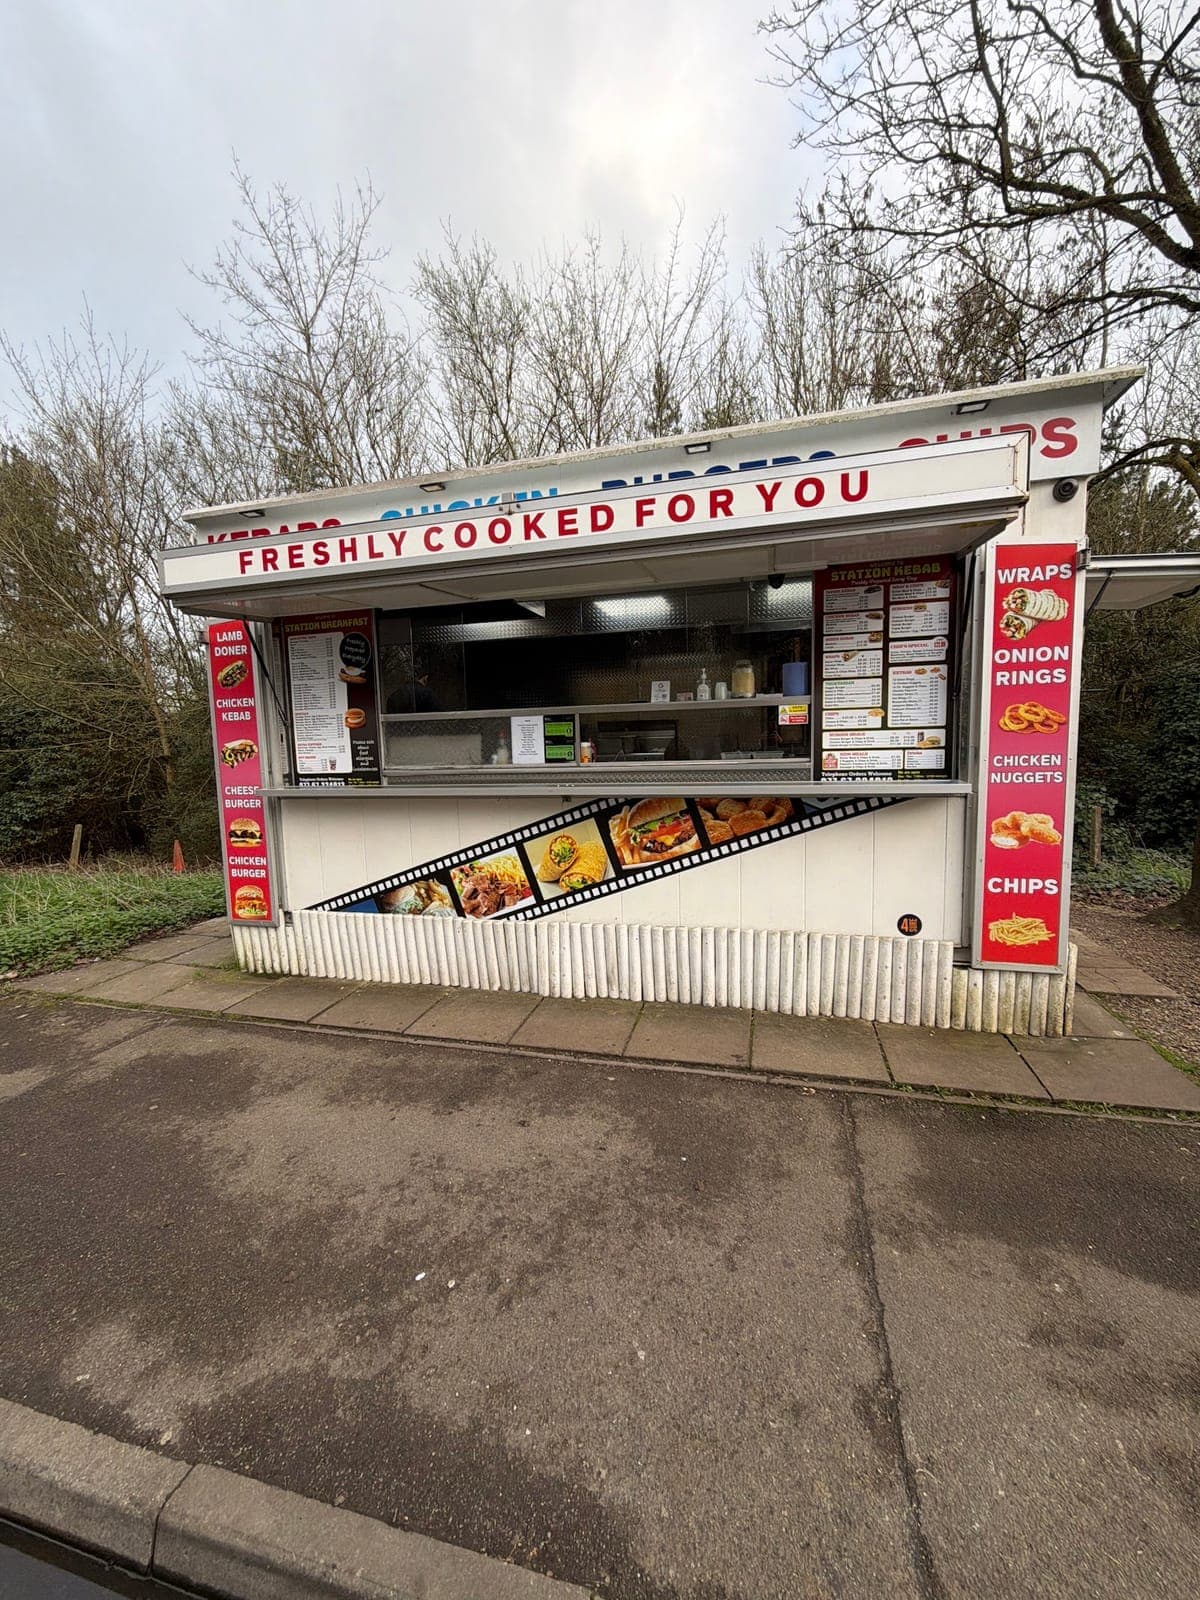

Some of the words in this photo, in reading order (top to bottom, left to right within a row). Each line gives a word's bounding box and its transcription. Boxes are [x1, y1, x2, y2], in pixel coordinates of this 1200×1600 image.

[239, 530, 407, 574] FRESHLY
[423, 504, 615, 552] COOKED
[635, 488, 734, 528] FOR
[756, 470, 869, 513] YOU
[831, 567, 888, 582] STATION
[894, 562, 941, 577] KEBAB
[997, 563, 1072, 584] WRAPS
[216, 630, 243, 642] LAMB
[214, 645, 248, 657] DONER
[994, 645, 1069, 664] ONION
[996, 668, 1067, 686] RINGS
[216, 697, 254, 708] CHICKEN
[222, 711, 251, 721] KEBAB
[993, 754, 1061, 767] CHICKEN
[990, 771, 1063, 784] NUGGETS
[224, 799, 262, 809] BURGER
[228, 856, 267, 866] CHICKEN
[231, 868, 266, 878] BURGER
[987, 877, 1059, 895] CHIPS
